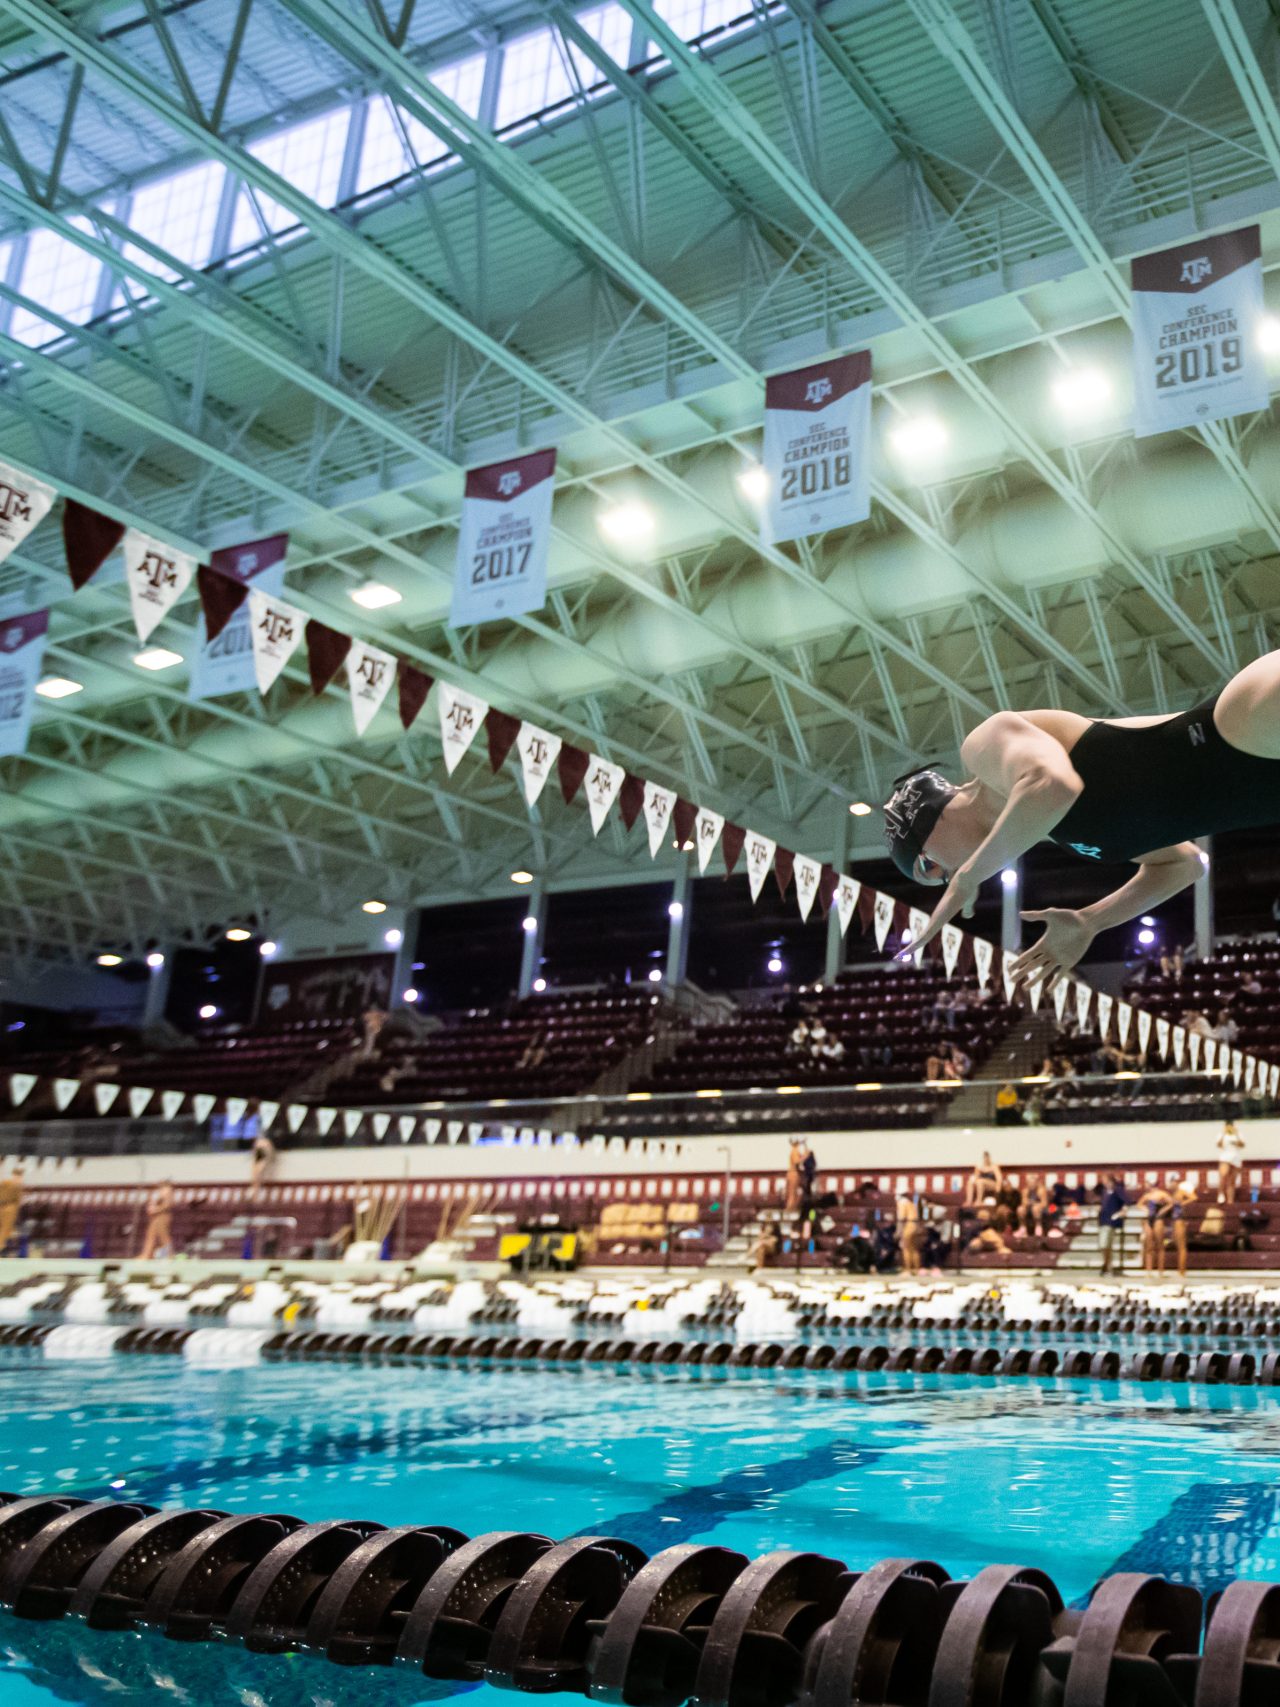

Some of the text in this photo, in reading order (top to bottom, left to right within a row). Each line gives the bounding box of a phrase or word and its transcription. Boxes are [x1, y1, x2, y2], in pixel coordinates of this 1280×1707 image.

[1162, 308, 1234, 334] CONFERENCE
[1187, 304, 1207, 317] SEC
[1159, 318, 1238, 350] CHAMPION
[1156, 336, 1241, 389] 2019
[788, 426, 847, 450] CONFERENCE
[809, 422, 826, 432] SEC
[784, 437, 849, 463] CHAMPION
[781, 455, 851, 502] 2018
[472, 541, 534, 585] 2017
